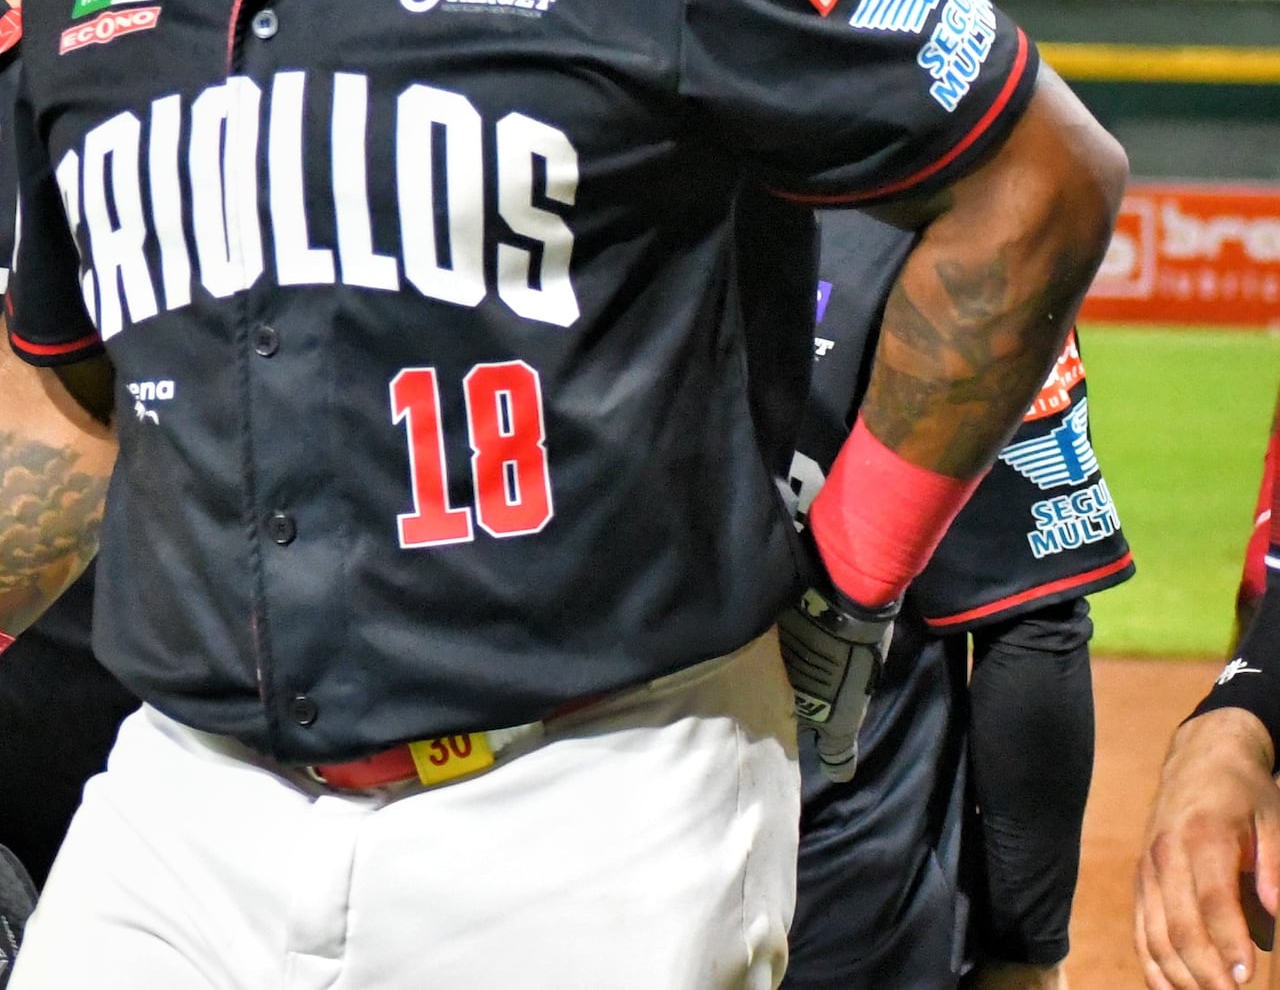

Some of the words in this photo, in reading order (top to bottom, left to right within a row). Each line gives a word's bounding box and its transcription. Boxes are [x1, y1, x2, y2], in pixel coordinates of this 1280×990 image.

[63, 11, 155, 48] ECONO
[126, 380, 175, 401] ena
[389, 360, 553, 549] 18
[429, 734, 472, 767] 30
